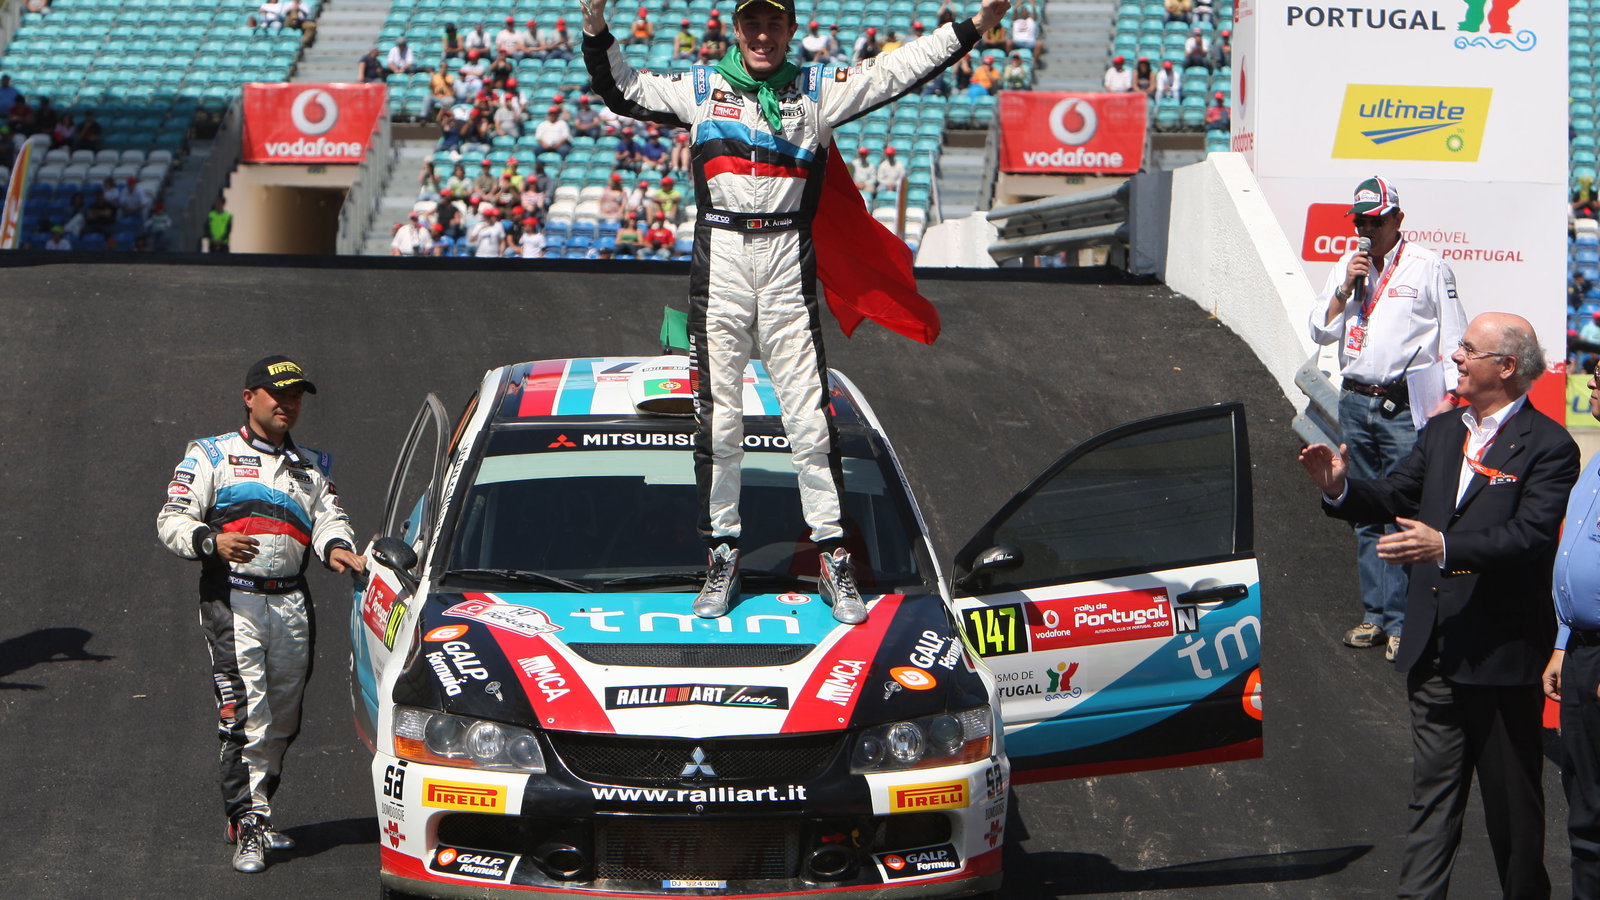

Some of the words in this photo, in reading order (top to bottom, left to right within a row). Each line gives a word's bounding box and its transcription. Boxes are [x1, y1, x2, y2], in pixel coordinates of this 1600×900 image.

[1286, 5, 1446, 31] PORTUGAL
[1359, 98, 1464, 121] ultimate
[264, 136, 362, 157] vodafone
[1023, 146, 1124, 168] vodafone
[705, 212, 730, 224] sparco
[1400, 228, 1469, 245] TOMÓVEL
[1442, 248, 1524, 263] PORTUGAL
[583, 433, 694, 446] MITSUBIS
[739, 435, 791, 448] OTO
[1073, 605, 1095, 613] rally
[1096, 602, 1108, 610] de
[1074, 604, 1168, 628] Portugal
[570, 607, 800, 634] tmn
[970, 606, 1016, 655] 147
[1153, 620, 1170, 628] 2009
[1176, 608, 1197, 632] N
[1035, 628, 1071, 639] vodafone
[909, 630, 945, 669] GALP
[442, 641, 488, 681] GALP
[425, 651, 462, 697] Fórmula
[530, 665, 571, 703] MCA
[825, 659, 867, 689] MCA
[1021, 670, 1034, 680] DE
[616, 687, 667, 705] RALLI
[689, 686, 726, 702] ART
[735, 694, 778, 704] Italy
[997, 684, 1042, 698] TUGAL
[427, 784, 498, 808] PIRELLI
[591, 784, 807, 803] www.ralliart.it
[896, 784, 963, 809] PIRELLI
[456, 854, 505, 866] GALP
[905, 850, 948, 864] GALP
[459, 864, 503, 877] Fórmula
